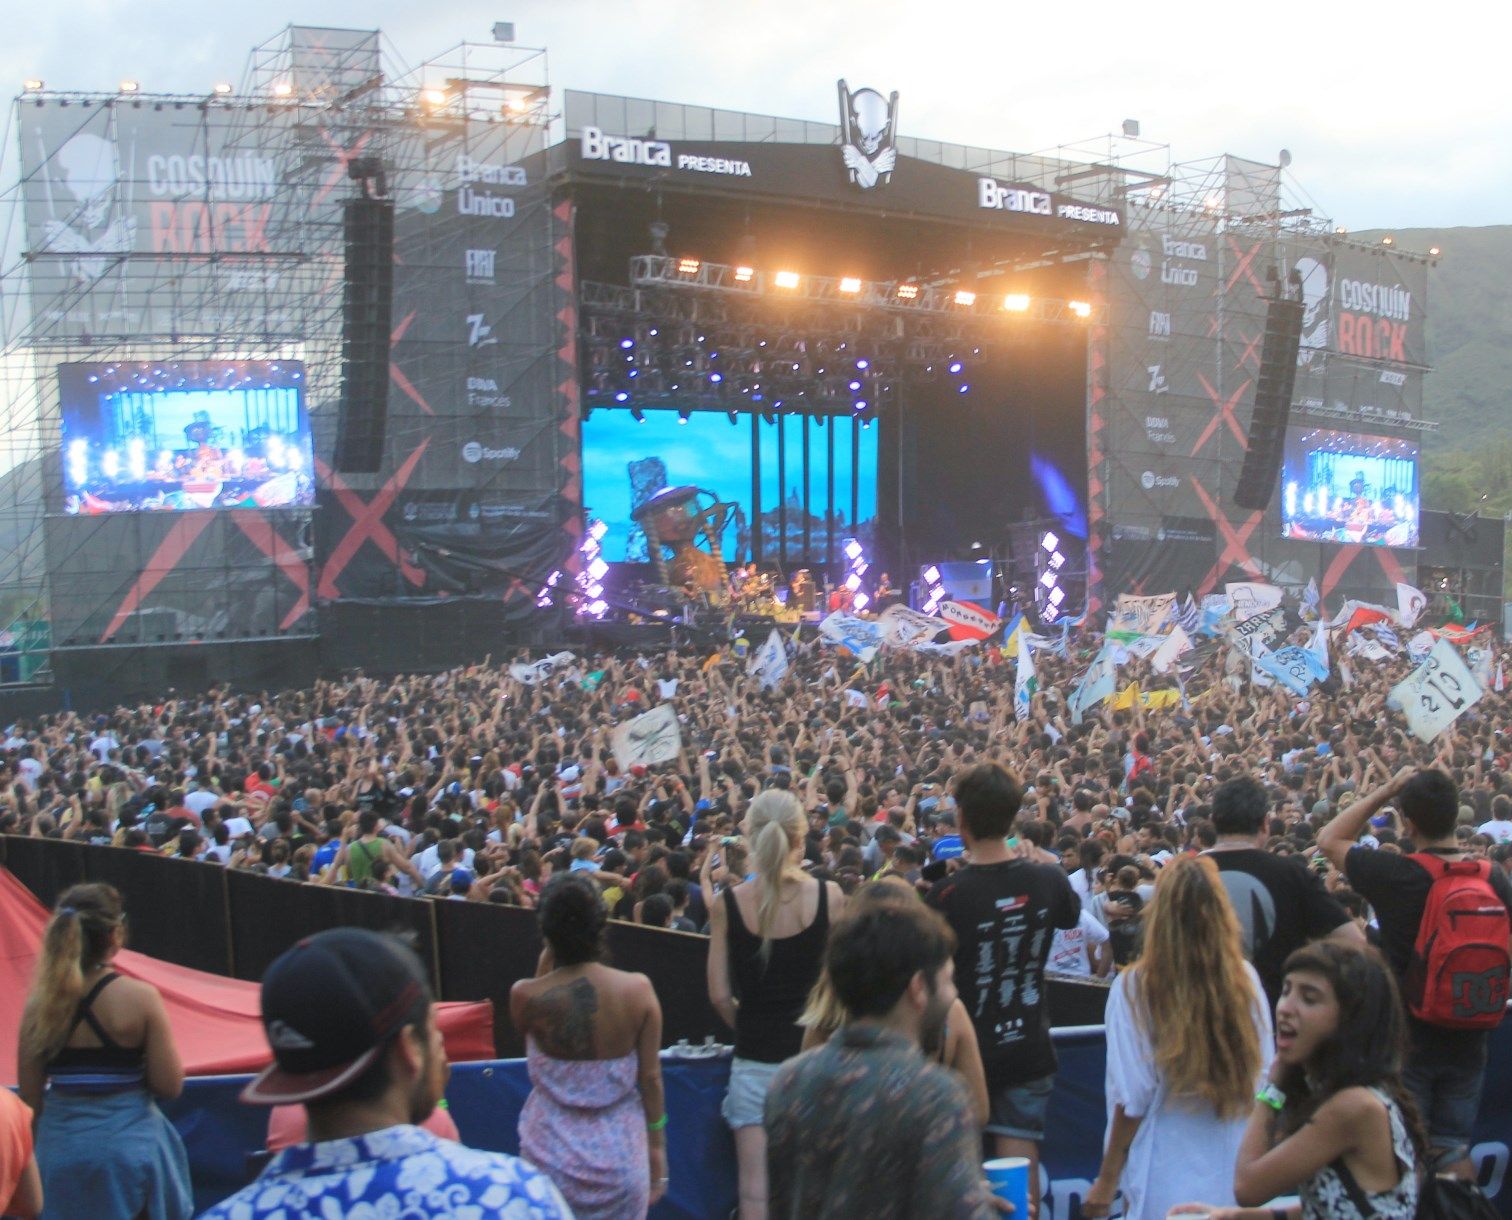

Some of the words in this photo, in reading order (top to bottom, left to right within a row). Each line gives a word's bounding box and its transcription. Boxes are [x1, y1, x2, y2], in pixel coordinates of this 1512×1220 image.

[148, 150, 277, 199] COSQUÍN
[458, 155, 528, 186] Branca
[582, 125, 672, 167] Branca
[678, 154, 752, 177] PRESENTA
[978, 177, 1052, 215] Branca
[1057, 204, 1119, 225] PRESENTA
[151, 200, 273, 266] ROCK
[1340, 278, 1411, 322] COSQUÍN
[1339, 311, 1408, 369] ROCK
